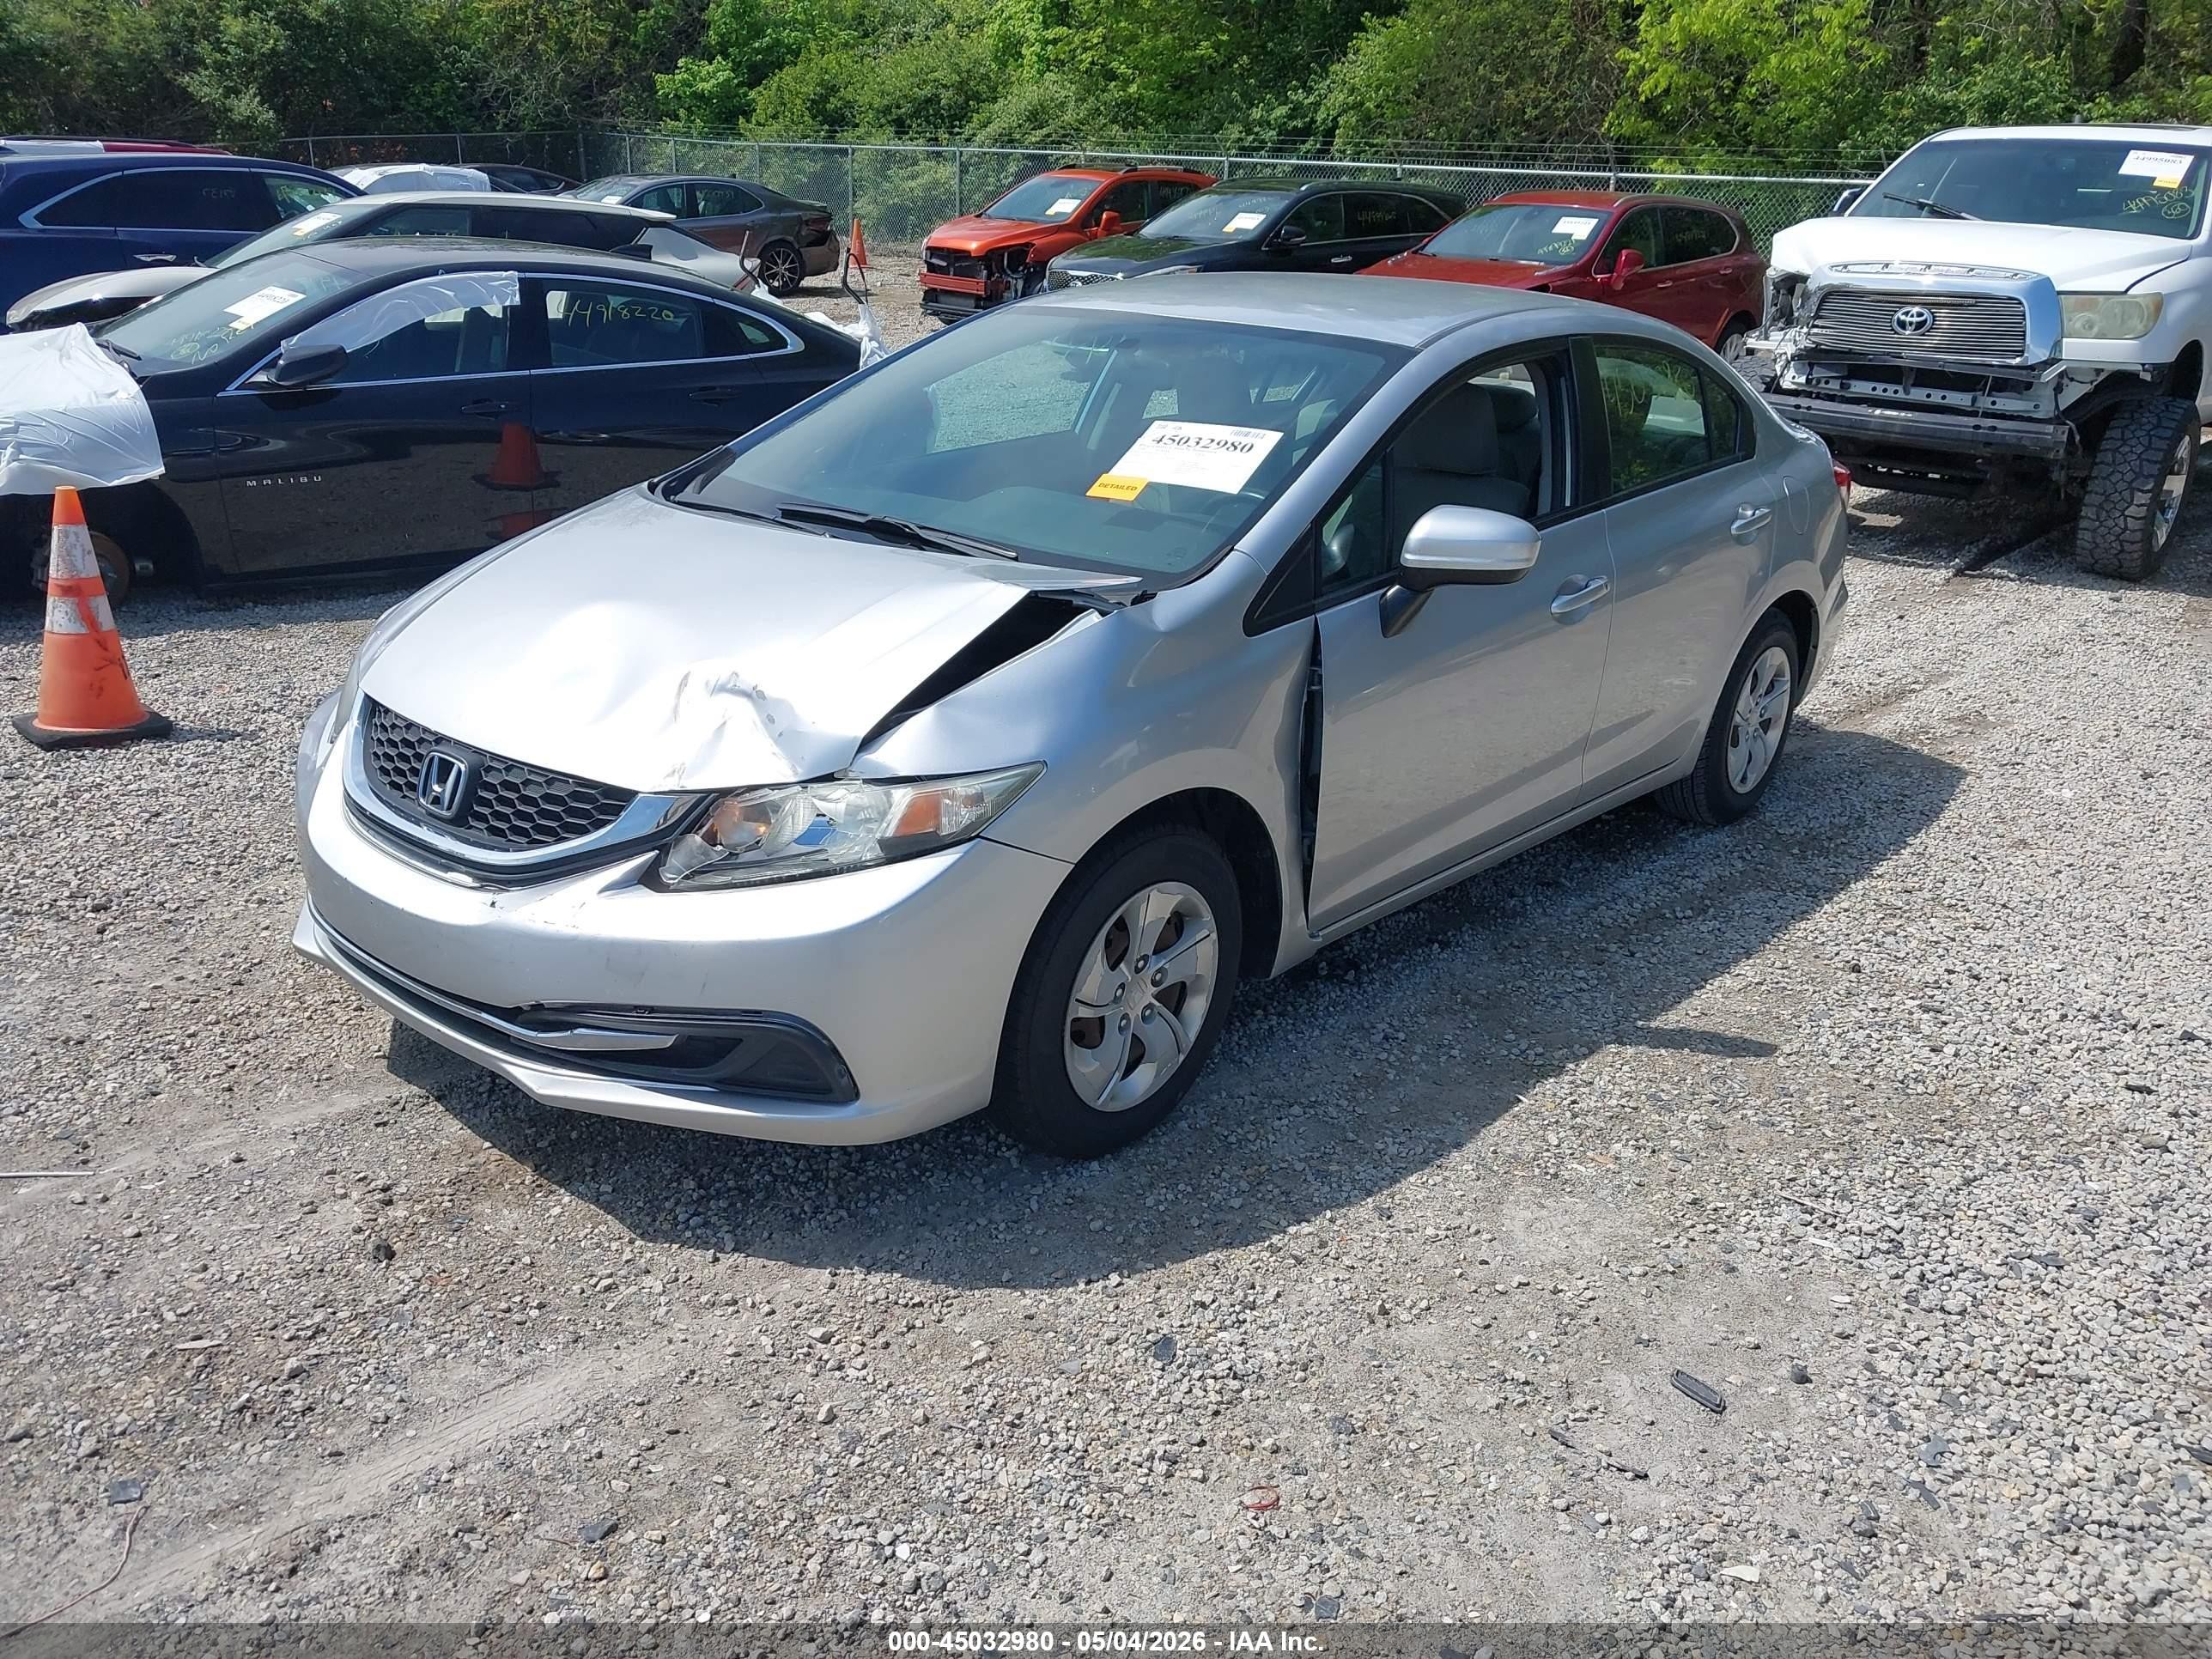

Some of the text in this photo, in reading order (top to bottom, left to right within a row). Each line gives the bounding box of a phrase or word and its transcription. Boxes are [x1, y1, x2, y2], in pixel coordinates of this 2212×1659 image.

[556, 299, 675, 327] 44918220
[1152, 434, 1255, 454] 45032980
[246, 475, 322, 487] MALIBU
[1097, 482, 1139, 491] DETAILED
